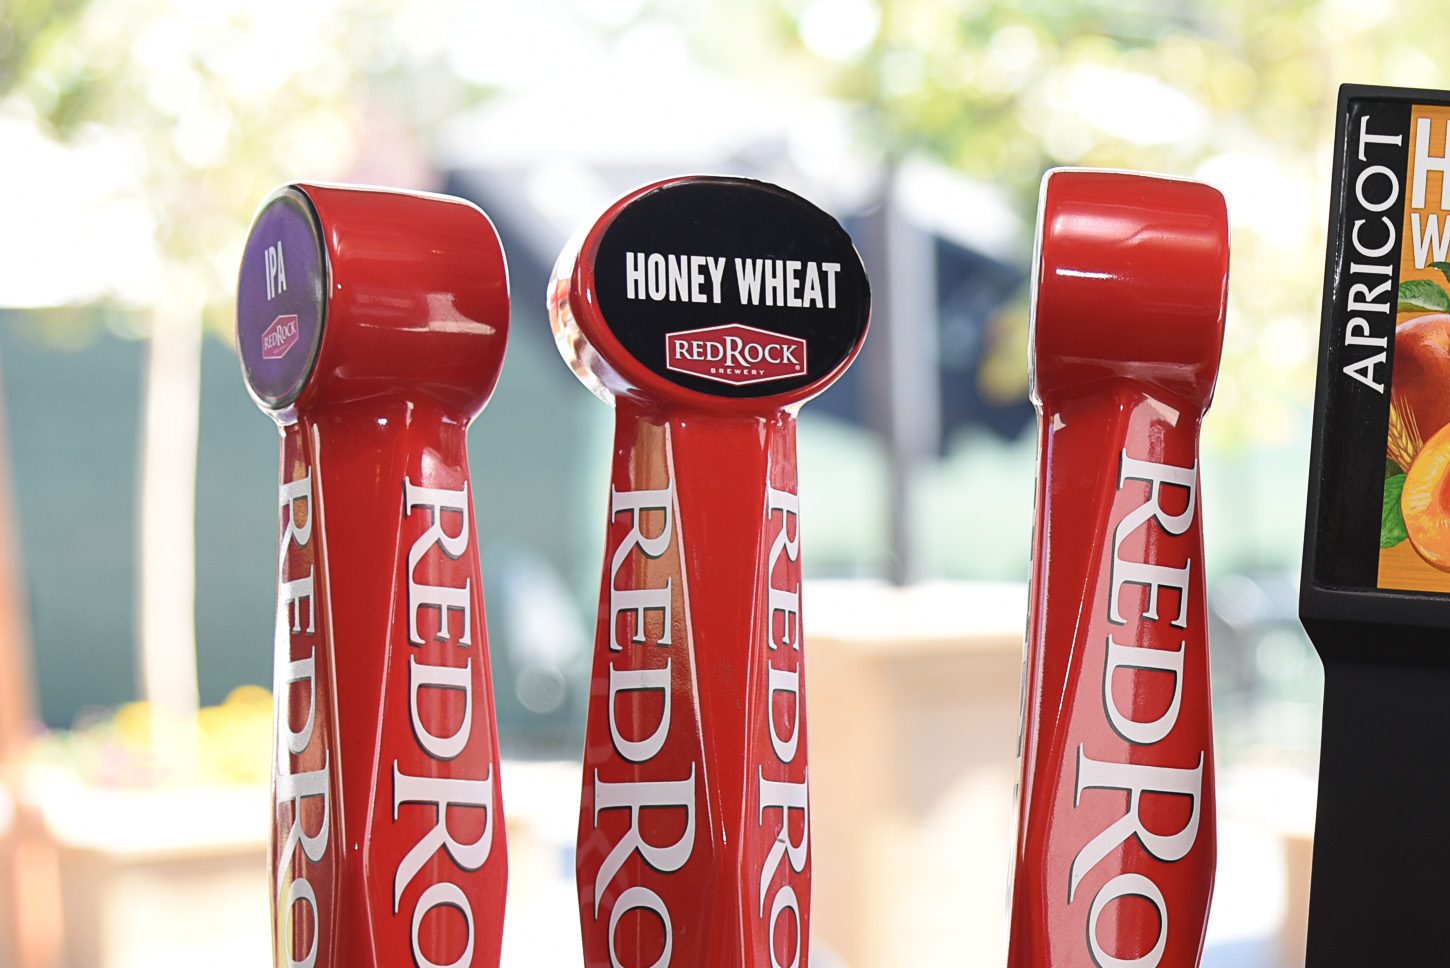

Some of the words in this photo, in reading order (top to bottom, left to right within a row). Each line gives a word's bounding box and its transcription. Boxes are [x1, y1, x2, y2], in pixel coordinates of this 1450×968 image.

[264, 240, 287, 301] IPA
[626, 251, 726, 304] HONEY
[734, 257, 841, 309] WHEAT
[1342, 114, 1403, 395] APRICOT
[710, 367, 765, 376] BREWERY
